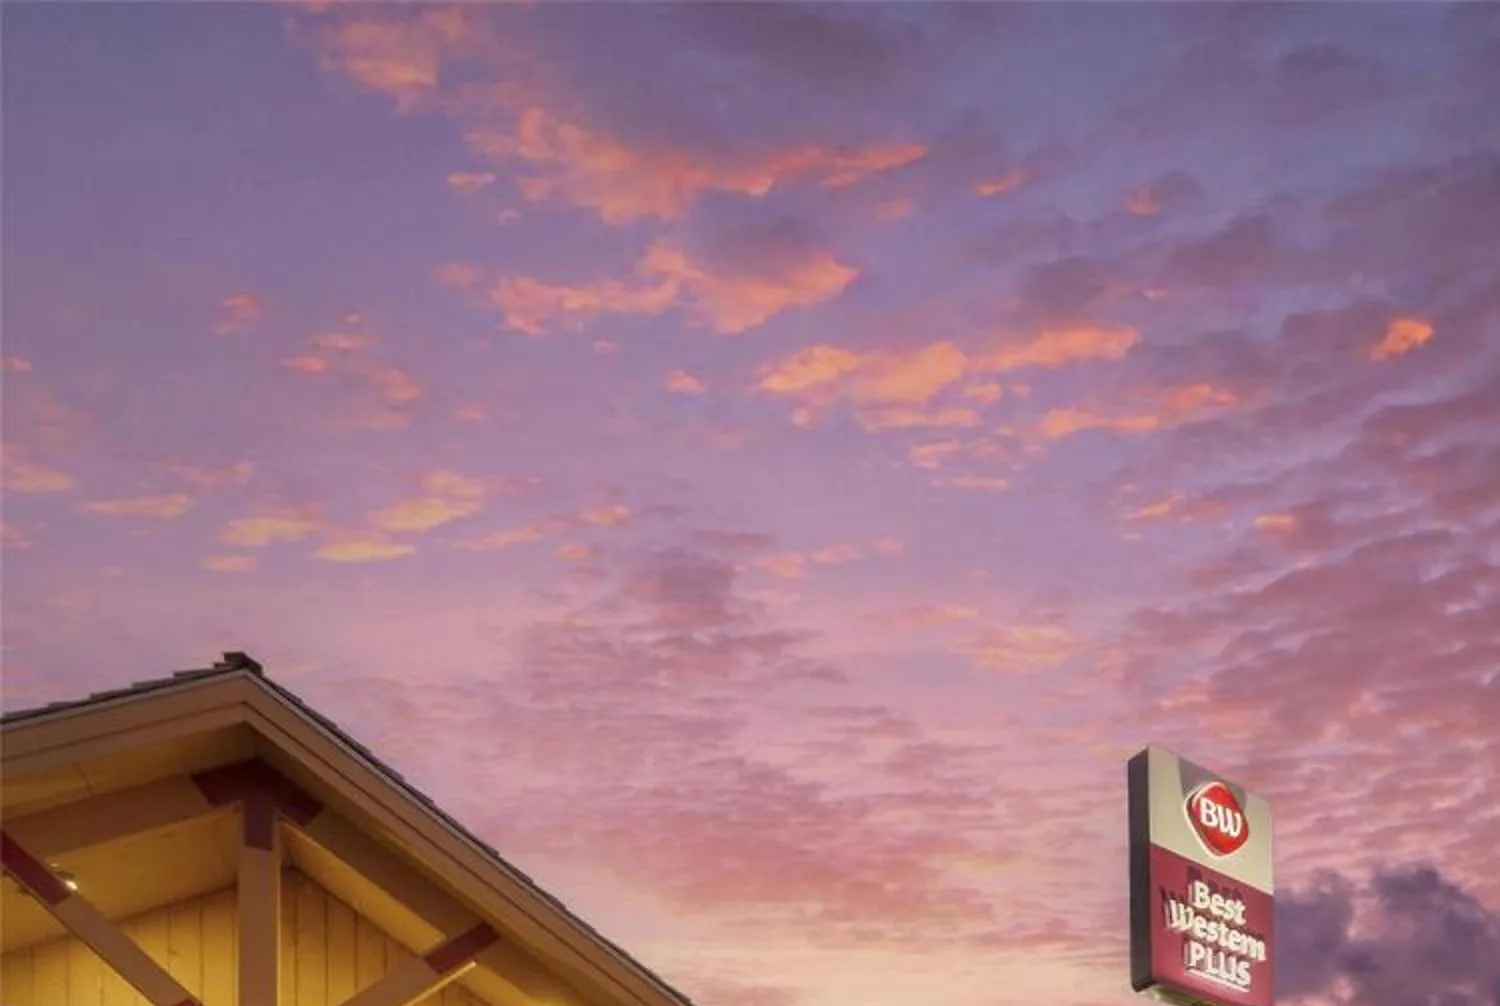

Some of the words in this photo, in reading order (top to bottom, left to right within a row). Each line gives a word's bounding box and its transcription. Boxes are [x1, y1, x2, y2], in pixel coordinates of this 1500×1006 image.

[1200, 798, 1242, 837] BW
[1191, 880, 1247, 926] Best
[1167, 899, 1267, 962] Western
[1187, 940, 1251, 985] PLUS
